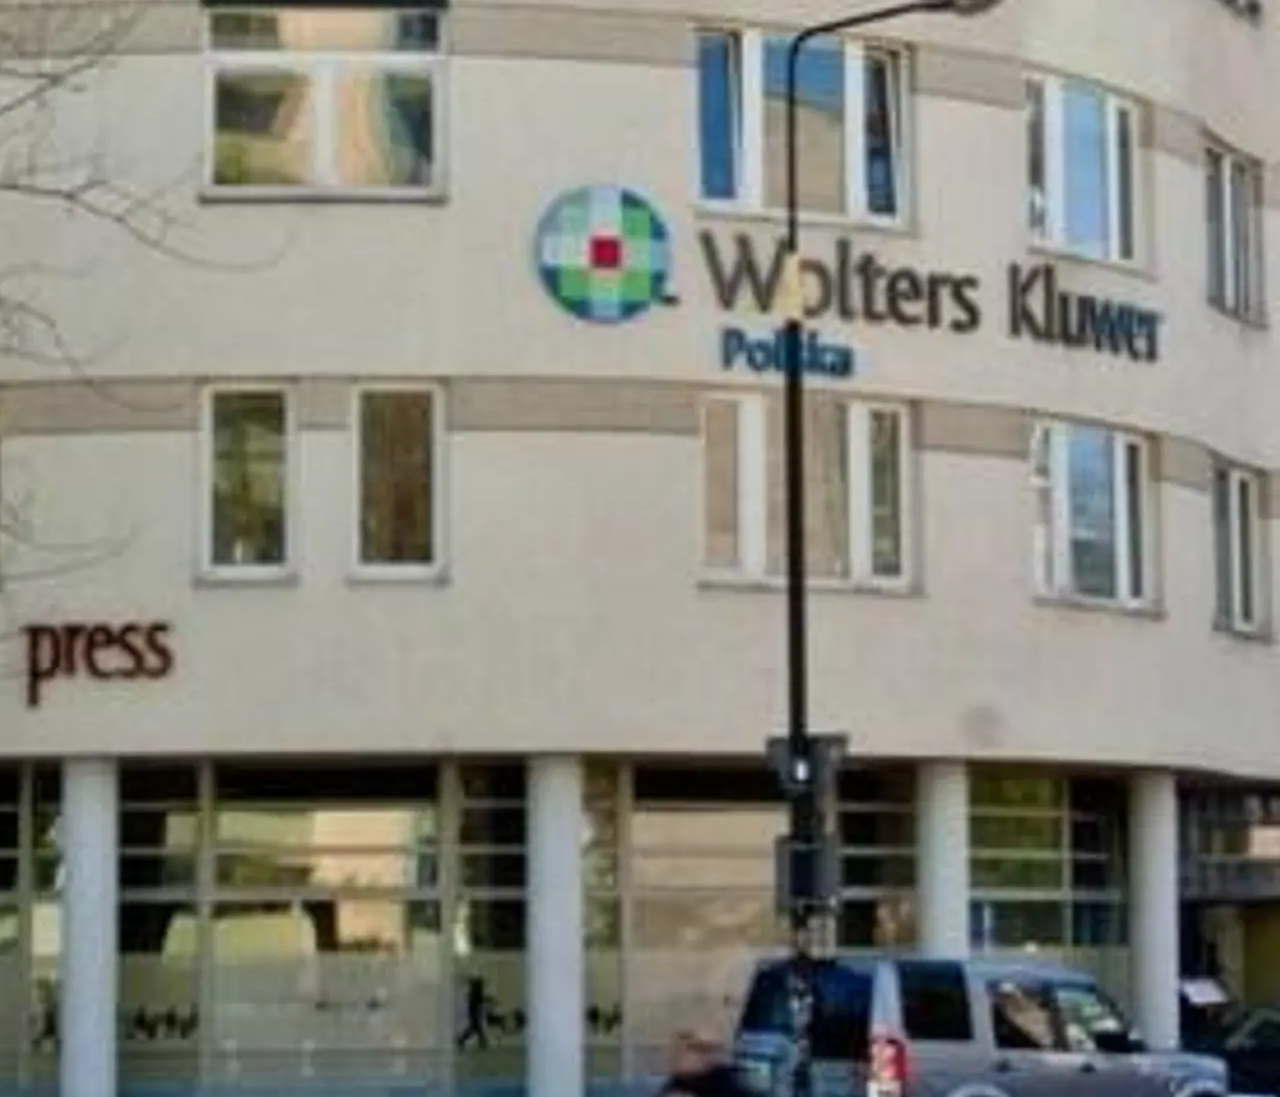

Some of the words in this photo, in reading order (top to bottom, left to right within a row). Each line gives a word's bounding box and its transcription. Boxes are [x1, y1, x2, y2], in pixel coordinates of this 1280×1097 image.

[700, 231, 981, 334] Wolters
[1007, 262, 1165, 364] Kluwer
[722, 328, 853, 378] Polka
[22, 623, 174, 708] press
